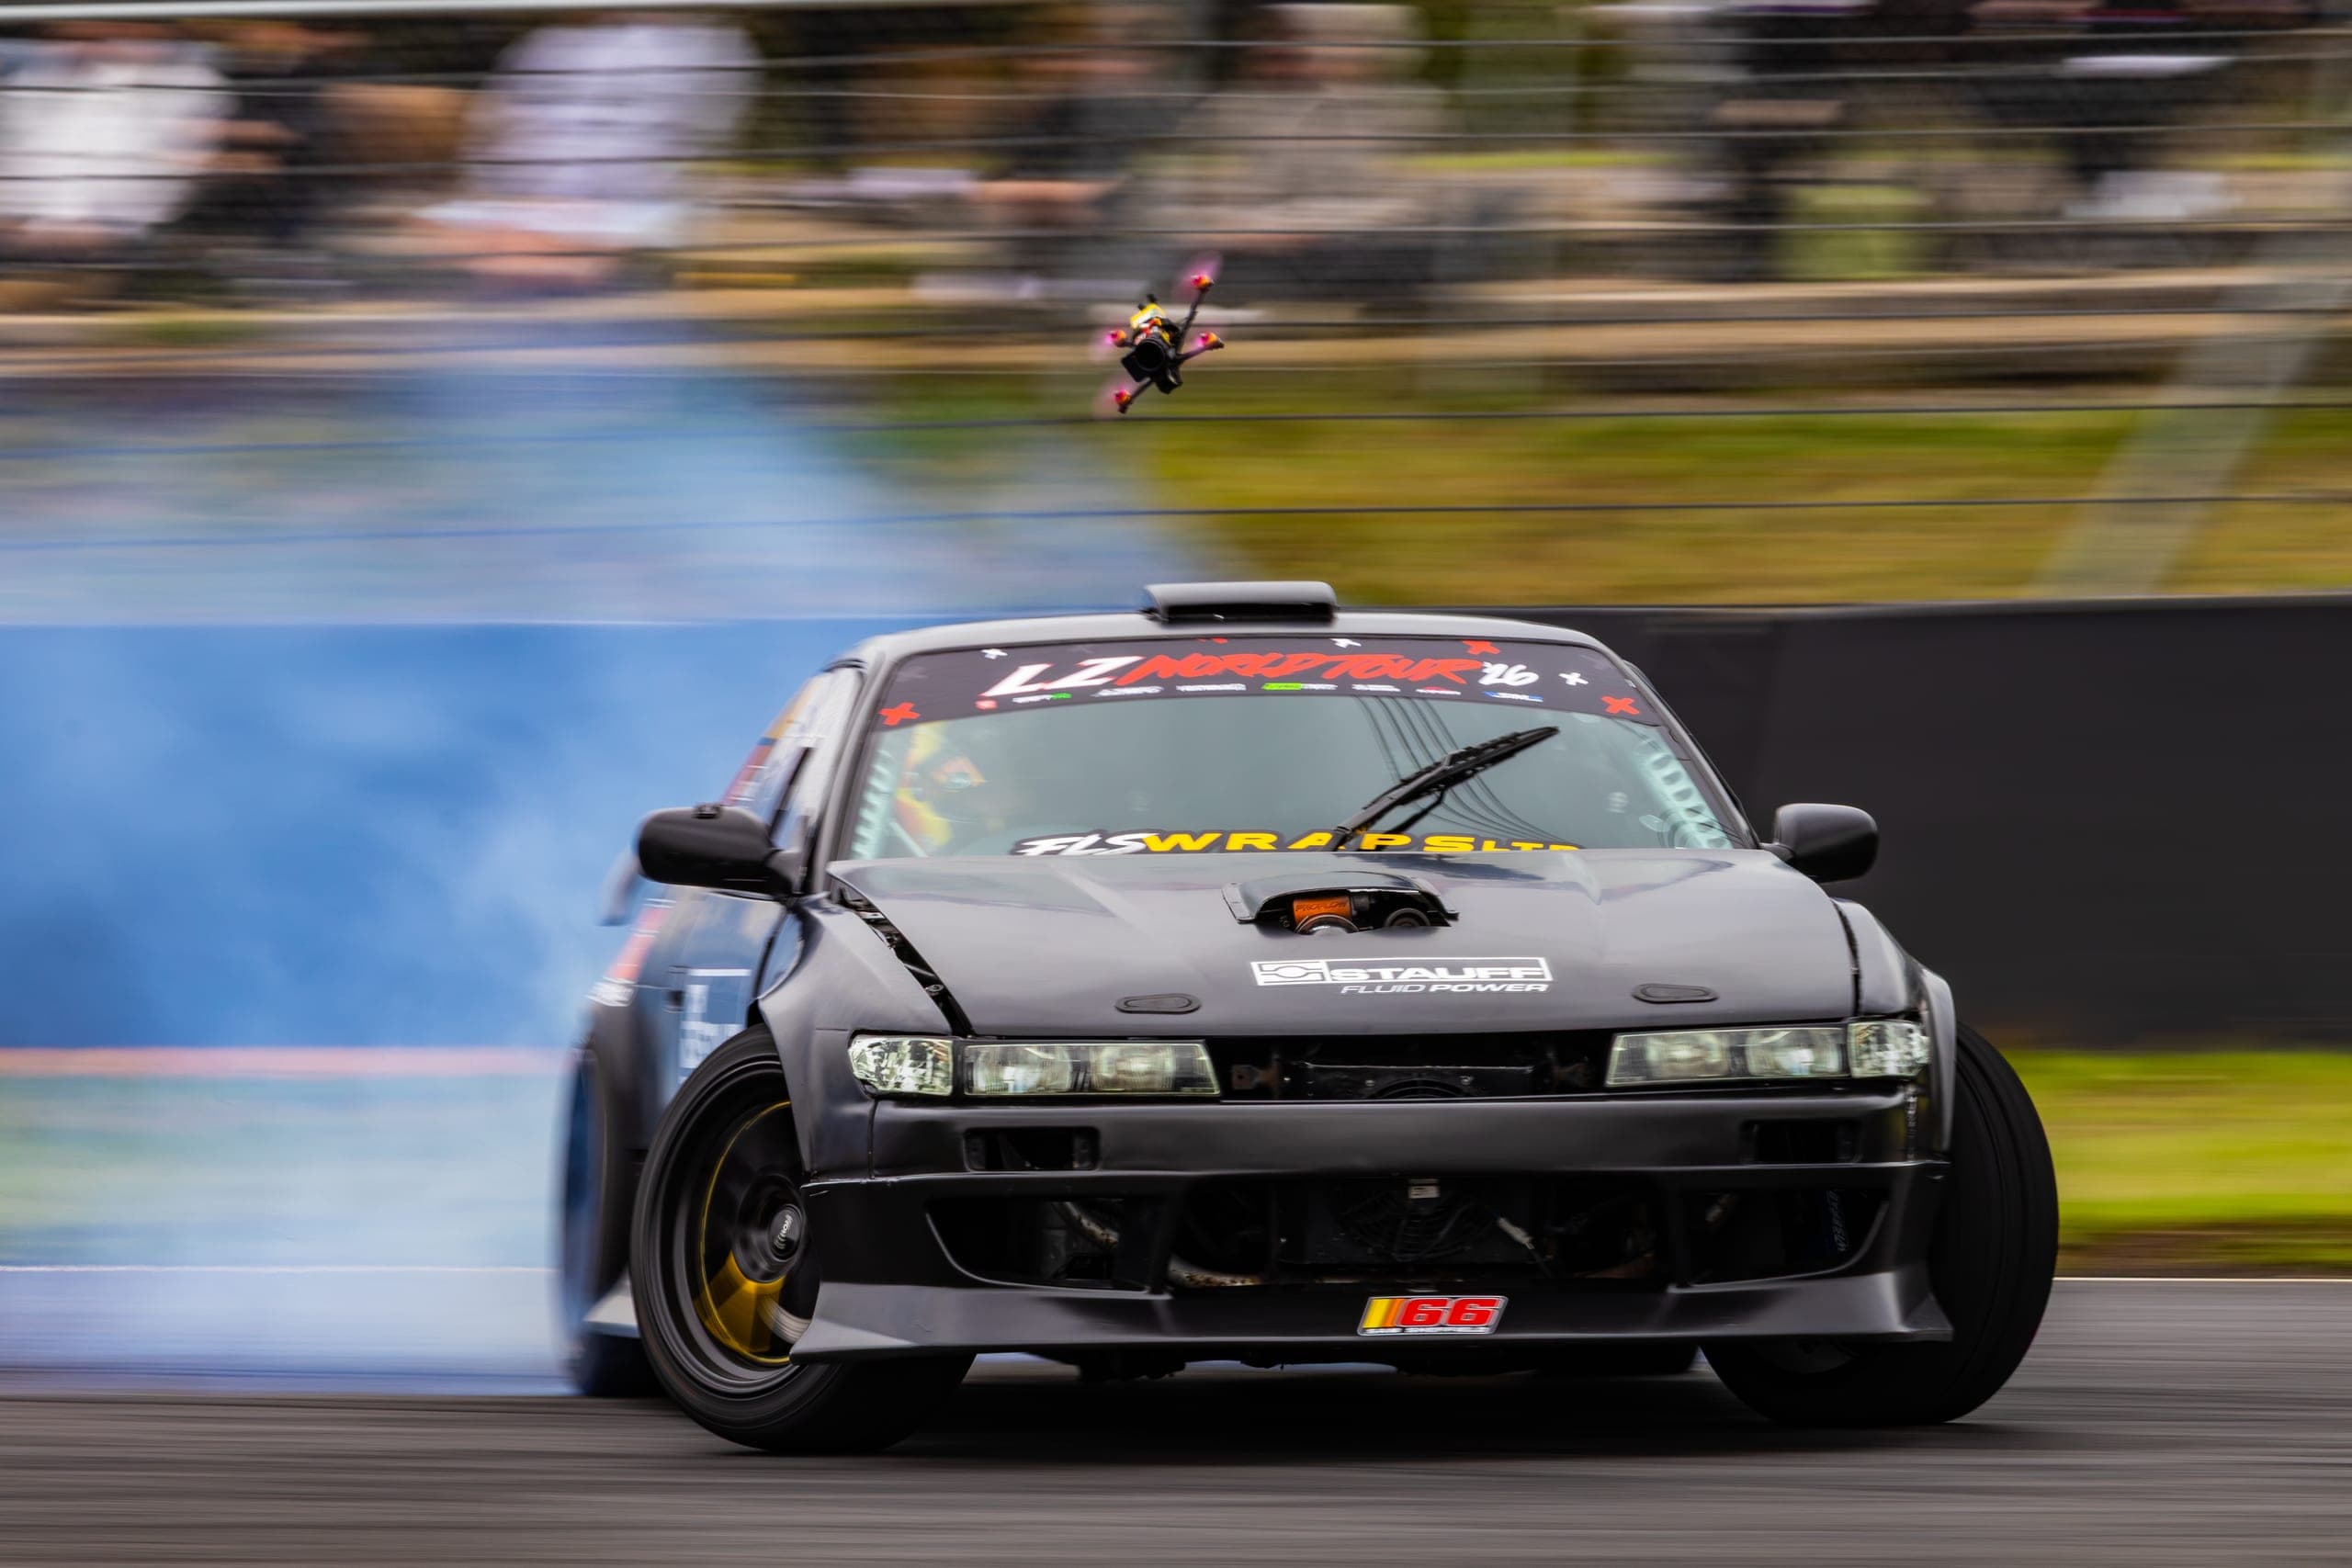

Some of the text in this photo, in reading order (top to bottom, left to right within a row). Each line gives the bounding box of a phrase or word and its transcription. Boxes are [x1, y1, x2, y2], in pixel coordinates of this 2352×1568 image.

[979, 655, 1146, 696] LZ
[1319, 653, 1482, 685] TOUR
[1329, 966, 1544, 981] STAUFF
[1340, 983, 1550, 994] FLUID POWER
[1396, 1296, 1503, 1327] 66
